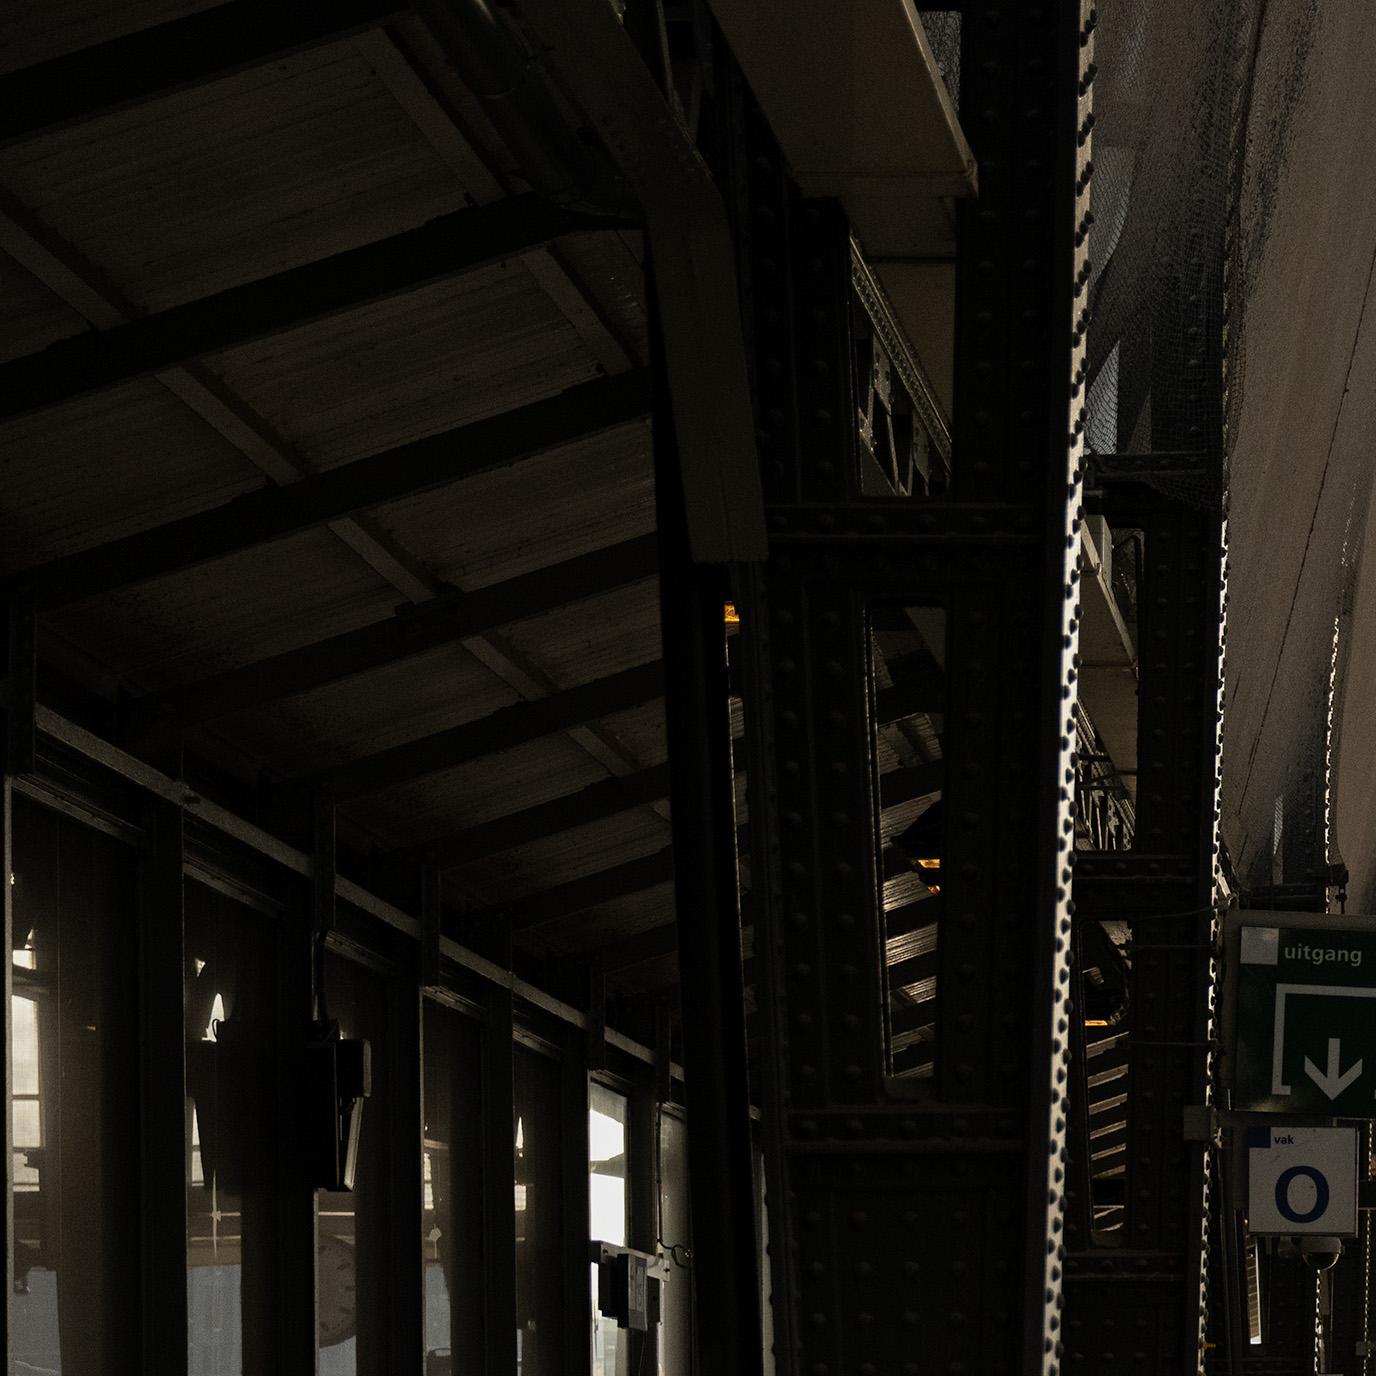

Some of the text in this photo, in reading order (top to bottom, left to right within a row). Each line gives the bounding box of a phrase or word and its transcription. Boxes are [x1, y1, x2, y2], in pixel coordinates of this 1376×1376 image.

[1284, 943, 1362, 966] uitgang
[1274, 1134, 1294, 1144] vak
[1275, 1165, 1329, 1223] O
